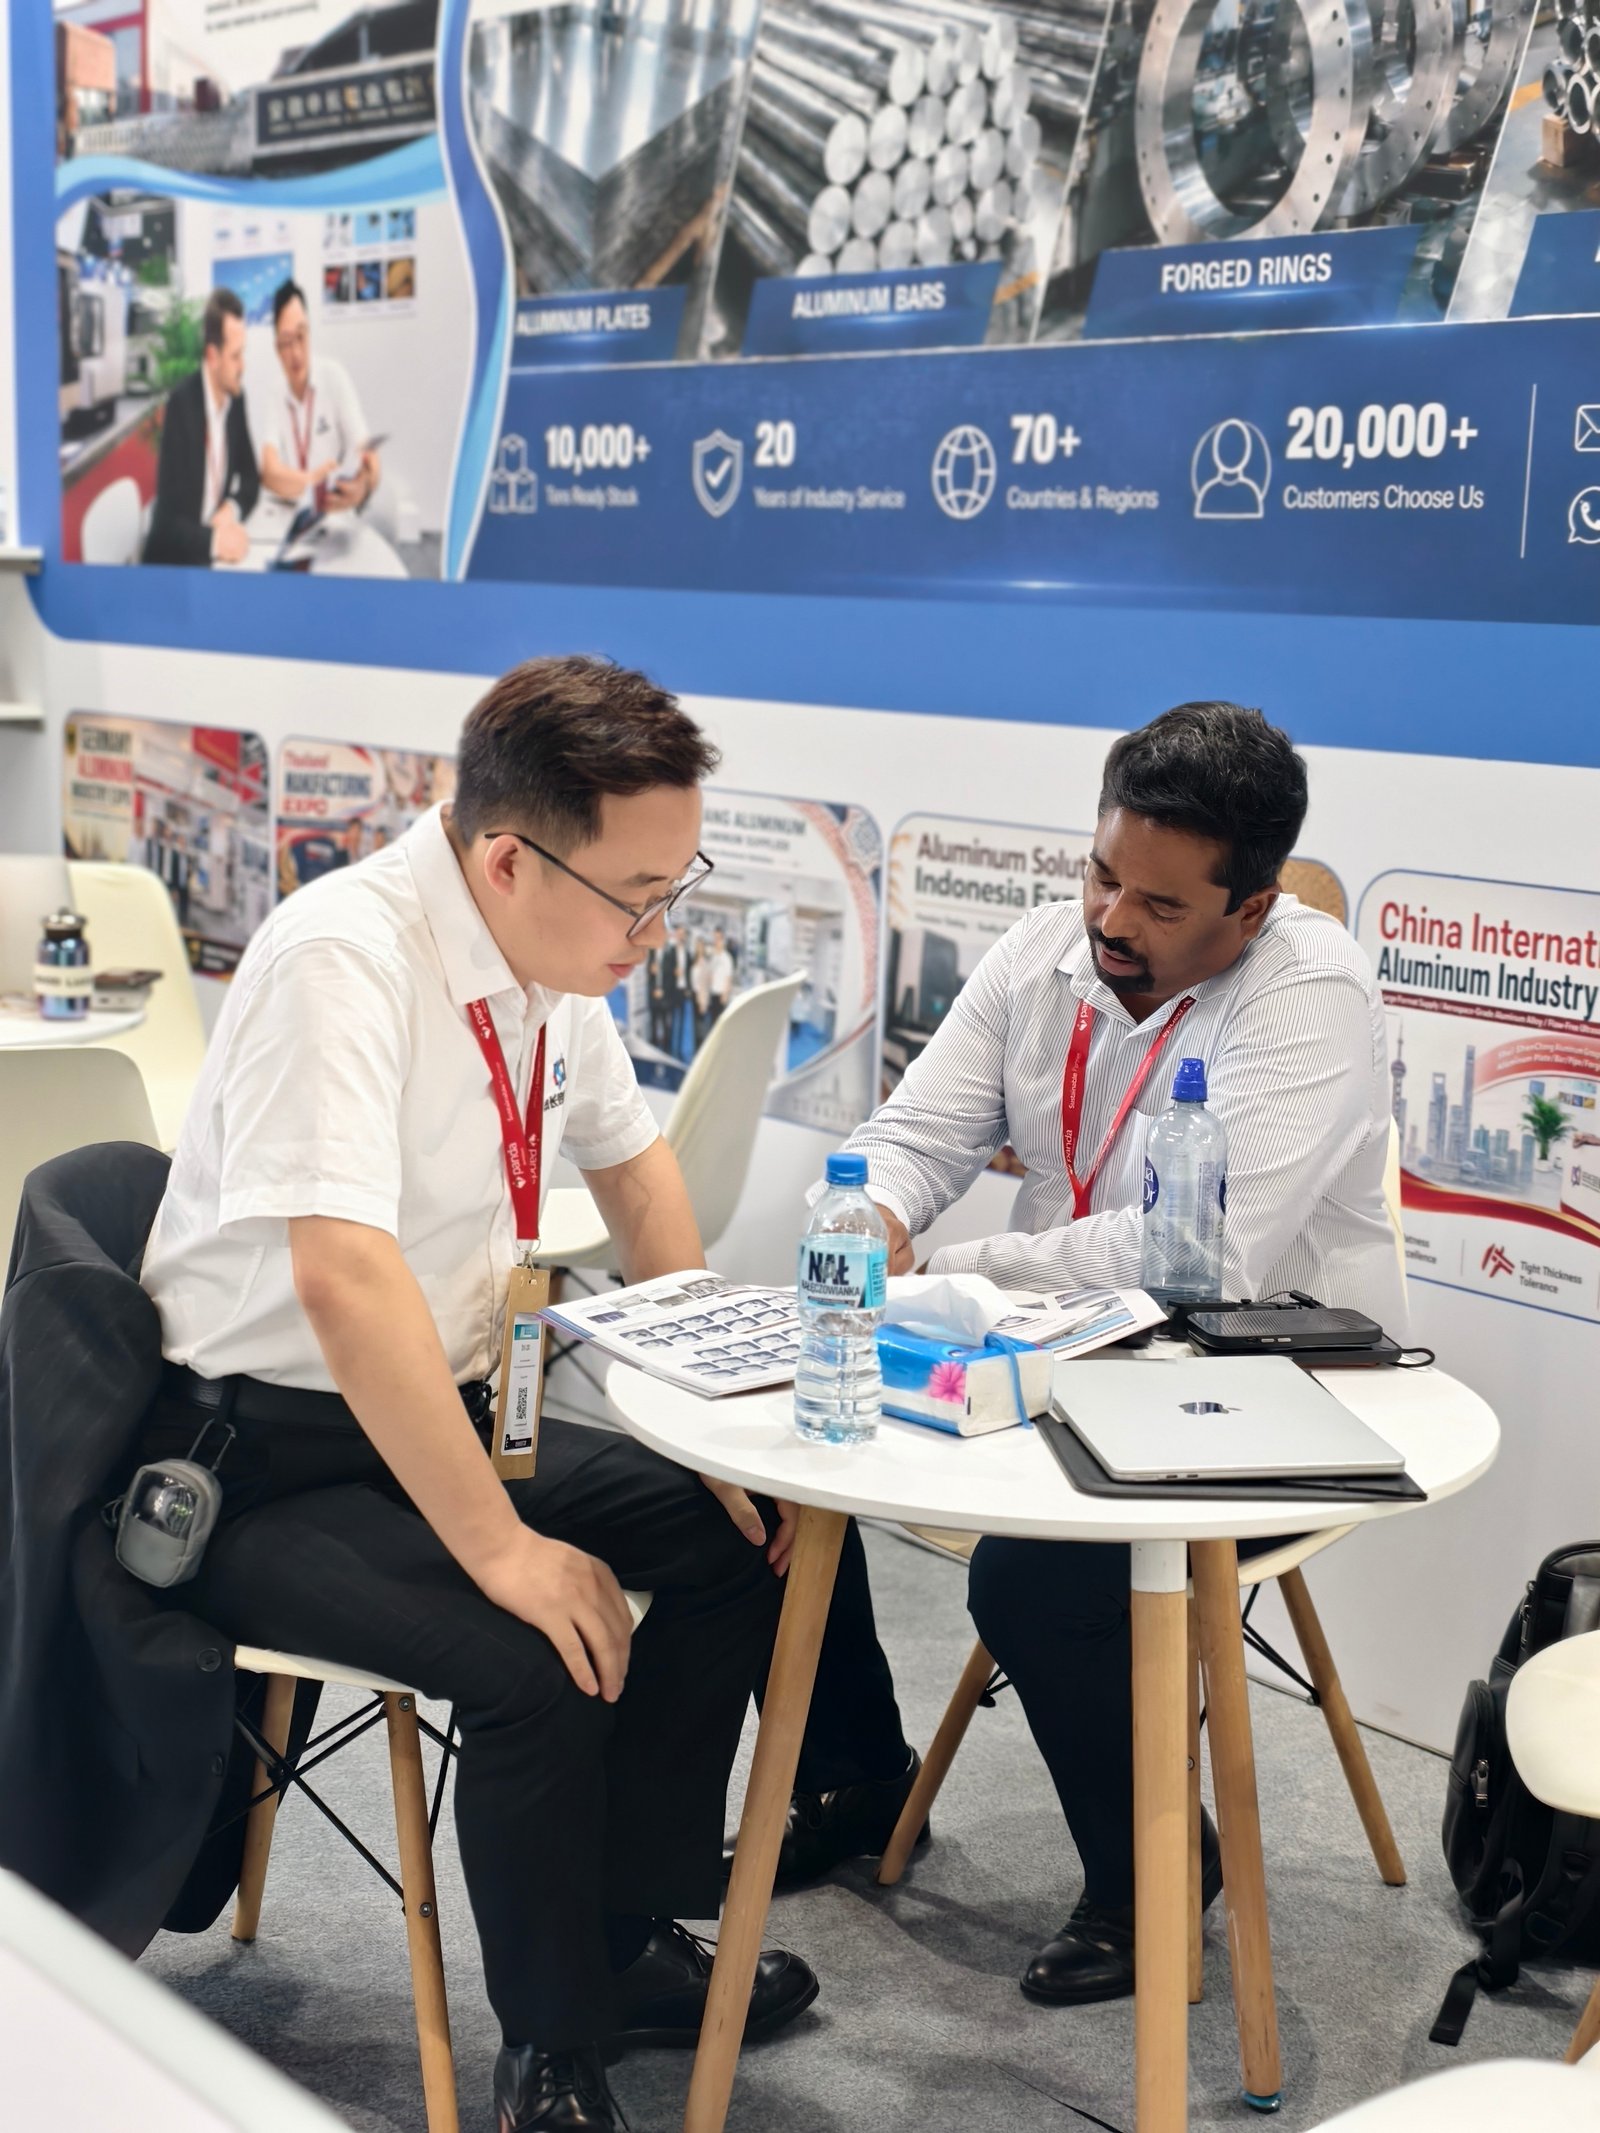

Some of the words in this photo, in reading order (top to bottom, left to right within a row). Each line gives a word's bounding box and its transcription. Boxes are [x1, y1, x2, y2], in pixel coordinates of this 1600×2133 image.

[1160, 258, 1252, 294] FORGED
[1257, 252, 1333, 286] RINGS
[791, 286, 891, 319] ALUMINUM
[894, 281, 947, 313] BARS
[516, 308, 593, 336] ALUMINUM
[595, 303, 650, 331] PLATES
[544, 424, 652, 477] 10,000+
[754, 420, 797, 467] 20
[1010, 413, 1082, 465] 70+
[1285, 402, 1479, 469] 20,000+
[752, 485, 787, 508] Years
[789, 485, 804, 508] of
[805, 485, 854, 514] Industry
[857, 485, 907, 508] Service
[1006, 484, 1077, 509] Countries
[1080, 485, 1092, 509] &
[1095, 484, 1159, 515] Regions
[1282, 484, 1380, 509] Customers
[1384, 483, 1454, 509] Choose
[1459, 484, 1484, 509] Us
[282, 797, 329, 816] EXPO
[916, 832, 1027, 873] Aluminum
[1032, 846, 1087, 880] Solut
[915, 866, 1026, 908] Indonesia
[1379, 901, 1463, 950] China
[1471, 912, 1600, 969] Internat
[1376, 946, 1491, 998] Aluminum
[1498, 962, 1599, 1022] Industry
[1068, 1071, 1079, 1110] Sustainable
[506, 1142, 525, 1176] panda
[808, 1250, 850, 1286] NAŁ
[1519, 1275, 1559, 1294] Tolerance
[1520, 1260, 1541, 1276] Tight
[1543, 1264, 1583, 1285] Thickness
